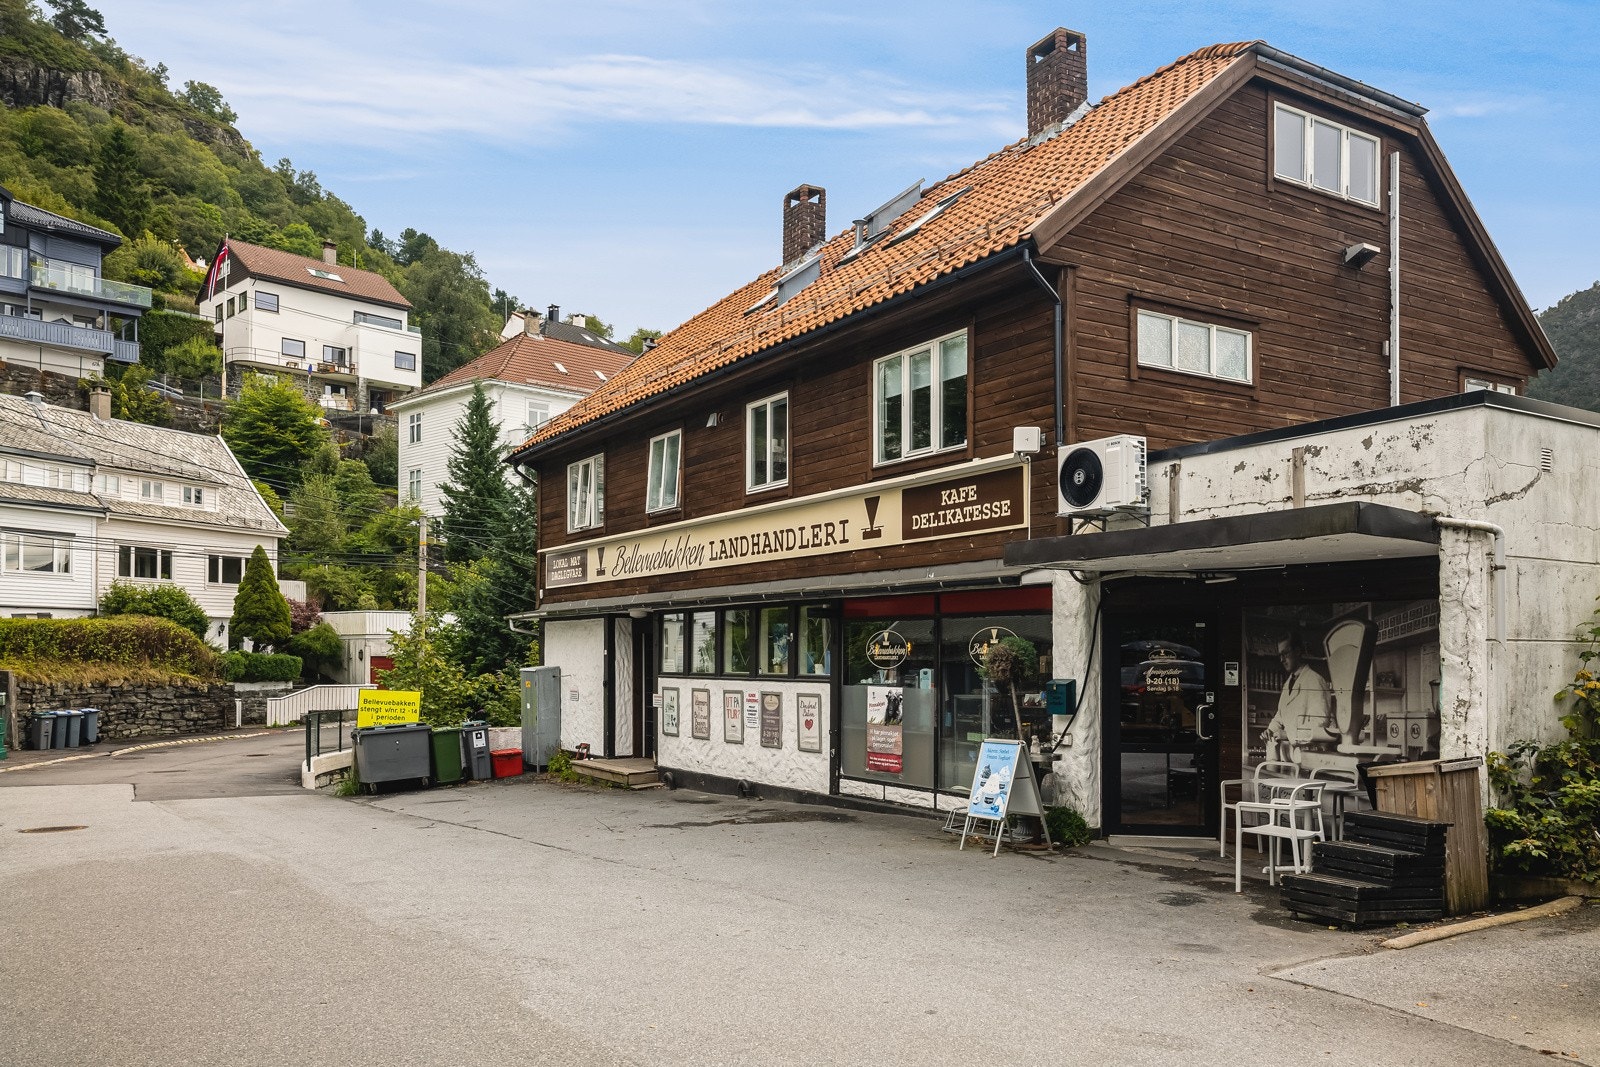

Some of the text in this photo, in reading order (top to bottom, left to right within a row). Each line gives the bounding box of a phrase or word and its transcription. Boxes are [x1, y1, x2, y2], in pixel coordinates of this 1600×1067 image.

[941, 485, 977, 505] KAFE
[912, 500, 1011, 530] DELIKATESSE
[611, 519, 850, 577] Bellevuebakken LANDHANDLERI
[552, 556, 580, 569] LOKAL MAT
[360, 706, 382, 714] stengt
[363, 698, 416, 706] Bellevuebakken
